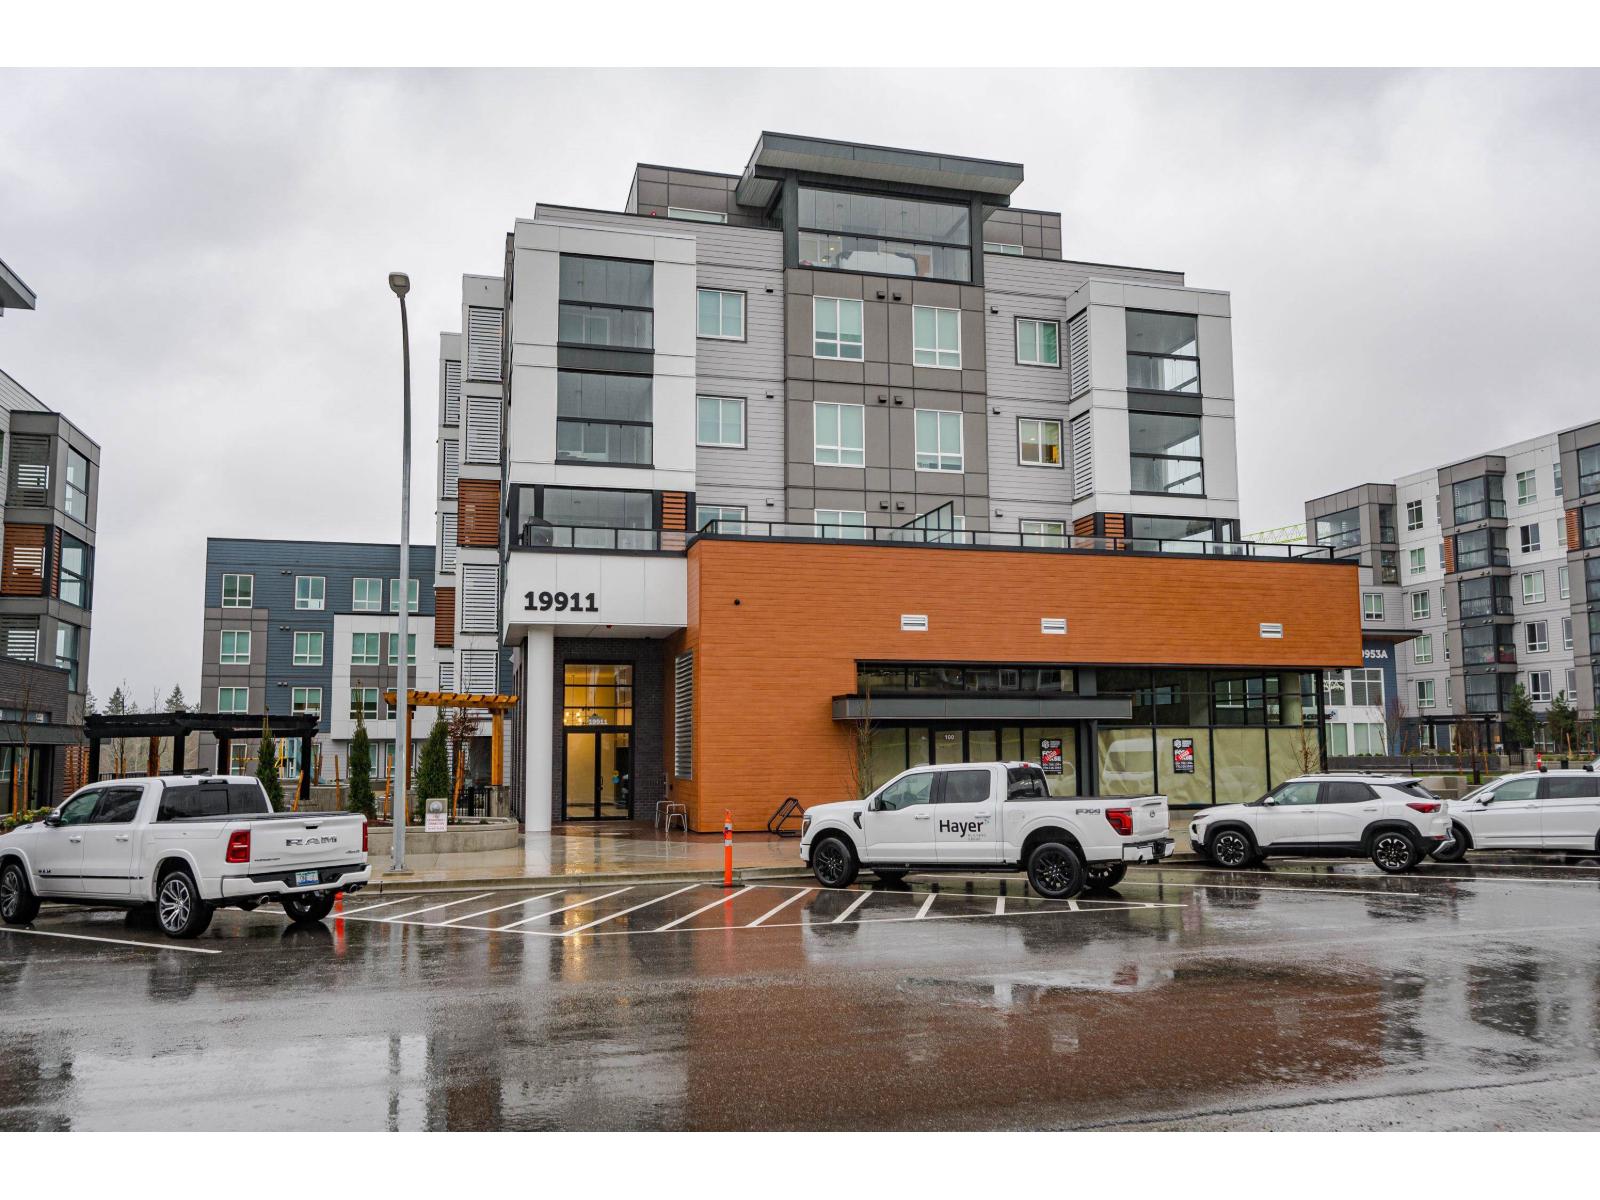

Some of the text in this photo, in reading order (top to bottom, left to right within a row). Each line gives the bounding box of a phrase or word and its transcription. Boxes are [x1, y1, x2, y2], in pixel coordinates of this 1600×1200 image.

[524, 591, 599, 612] 19911
[939, 819, 984, 838] Hayer
[286, 836, 337, 846] RAM
